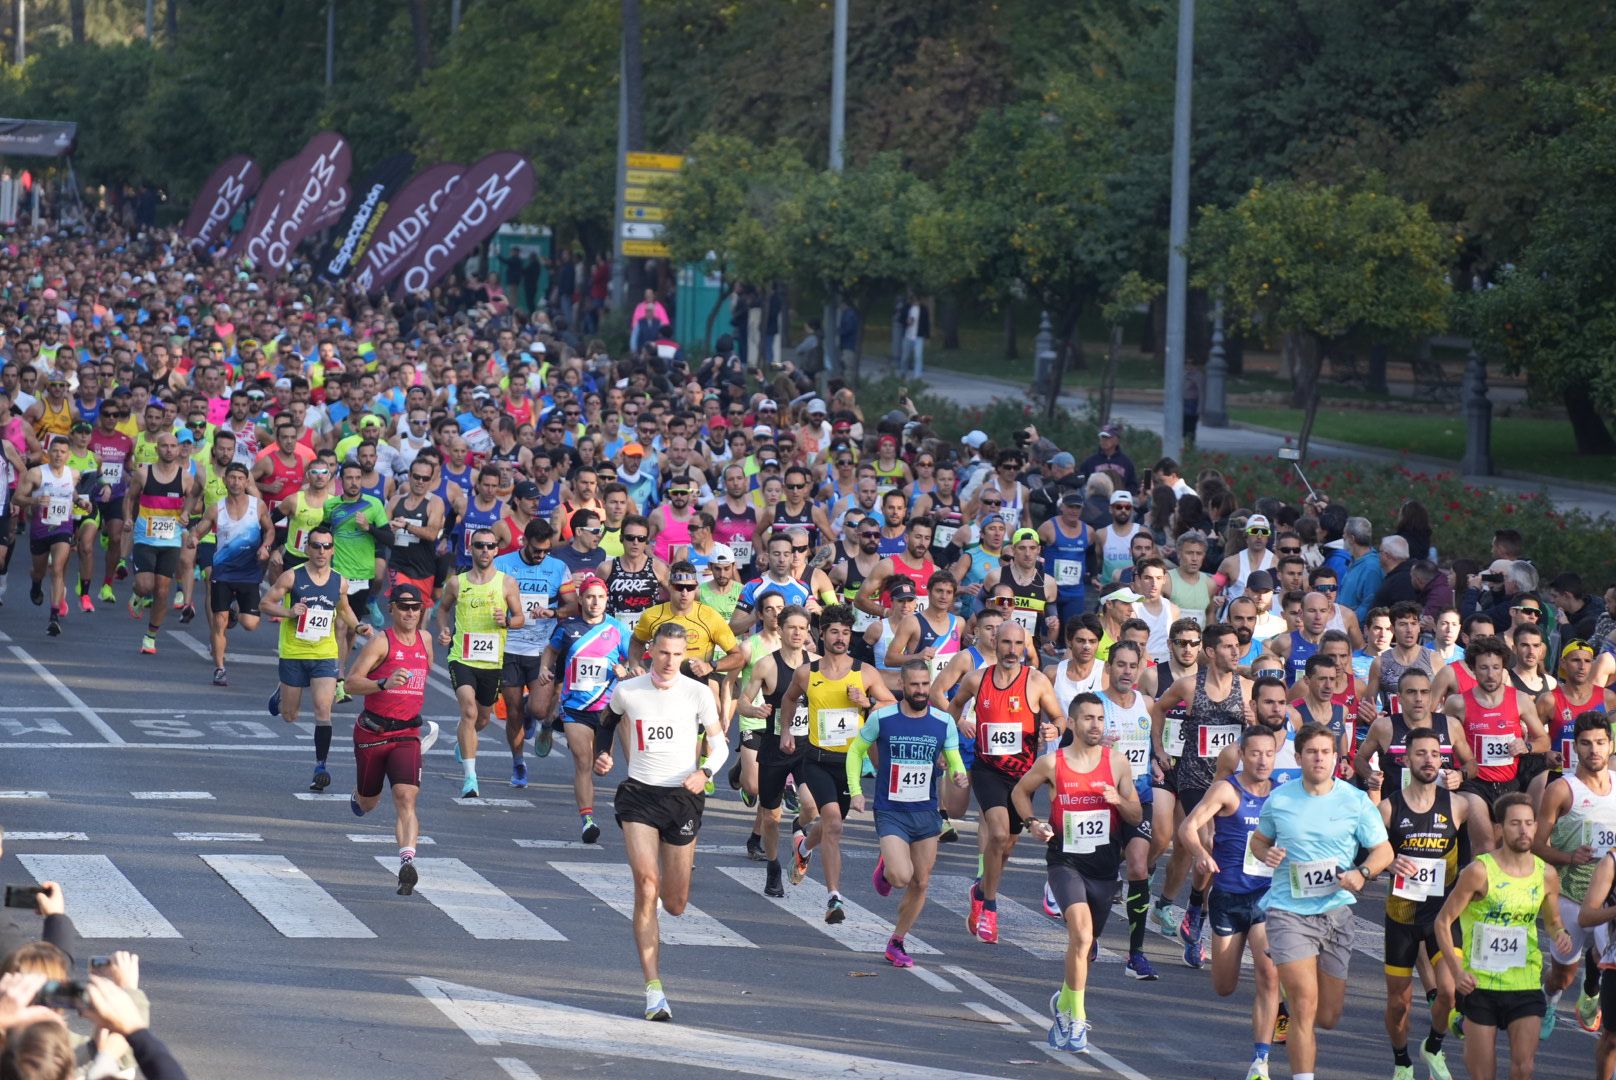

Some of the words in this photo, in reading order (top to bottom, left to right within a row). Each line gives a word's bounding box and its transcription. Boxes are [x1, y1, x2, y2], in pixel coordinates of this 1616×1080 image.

[269, 139, 344, 269] IMDECO
[404, 158, 526, 294] IMDECO
[52, 504, 66, 515] 160
[733, 547, 748, 557] 250
[1062, 566, 1079, 576] 473
[610, 578, 651, 593] CORRE
[309, 616, 328, 627] 420
[472, 639, 494, 652] 224
[580, 664, 601, 676] 317
[838, 717, 846, 729] 4
[647, 726, 673, 740] 260
[991, 731, 1015, 744] 463
[1211, 732, 1235, 746] 410
[902, 772, 926, 785] 413
[1077, 820, 1103, 836] 132
[1598, 831, 1616, 845] 38
[1304, 869, 1333, 885] 124
[1490, 938, 1518, 952] 434
